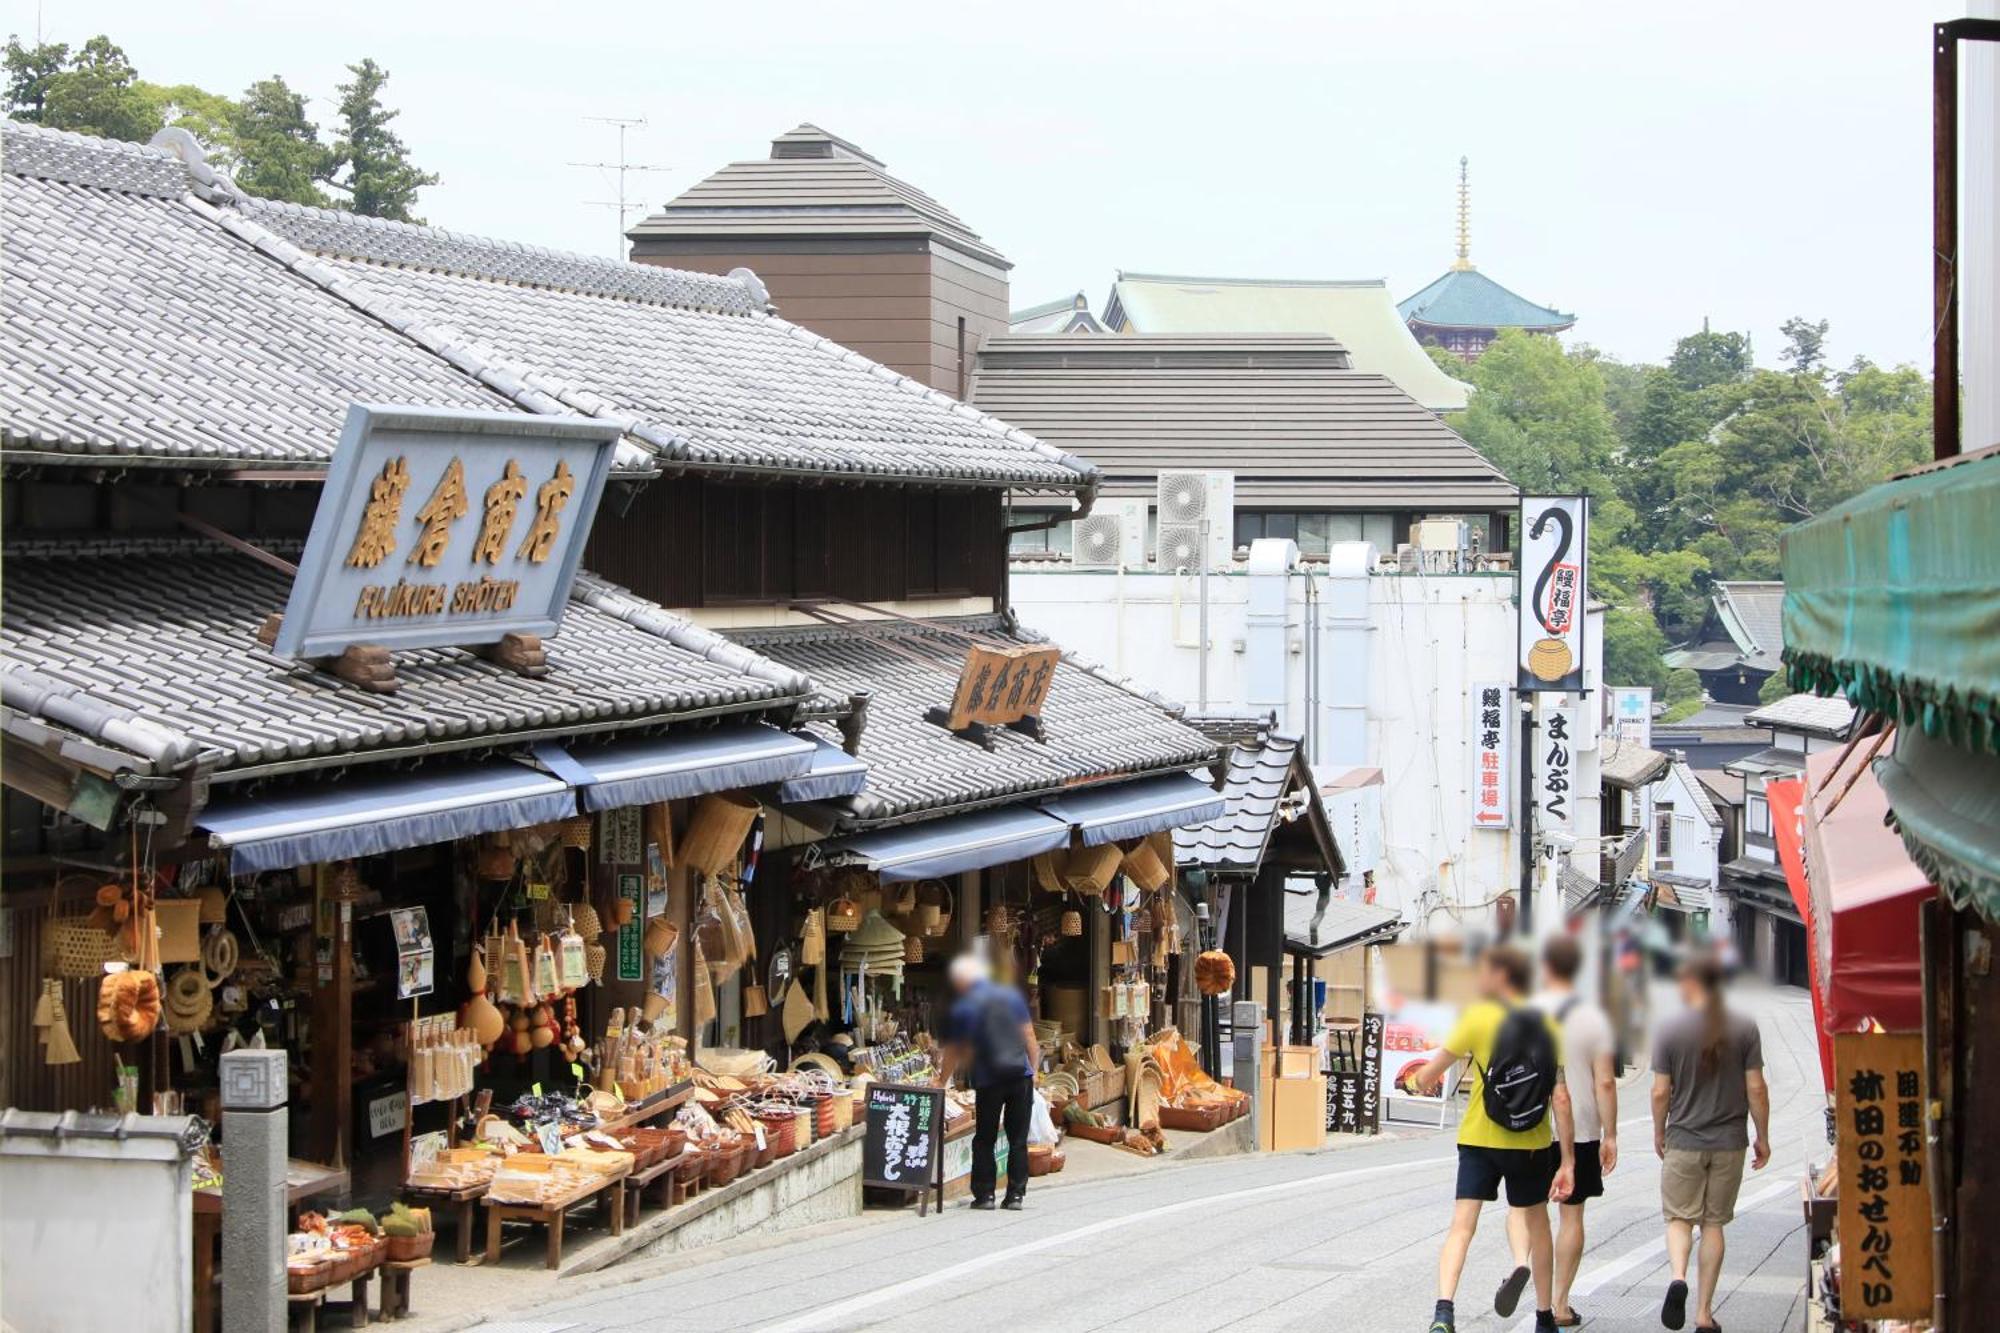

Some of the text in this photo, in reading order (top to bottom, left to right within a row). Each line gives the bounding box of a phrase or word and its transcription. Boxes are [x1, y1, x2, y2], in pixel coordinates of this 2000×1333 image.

[1551, 568, 1574, 627] 鰻福亭
[1545, 712, 1569, 821] まんぷく
[884, 1103, 911, 1181] 大根おろし
